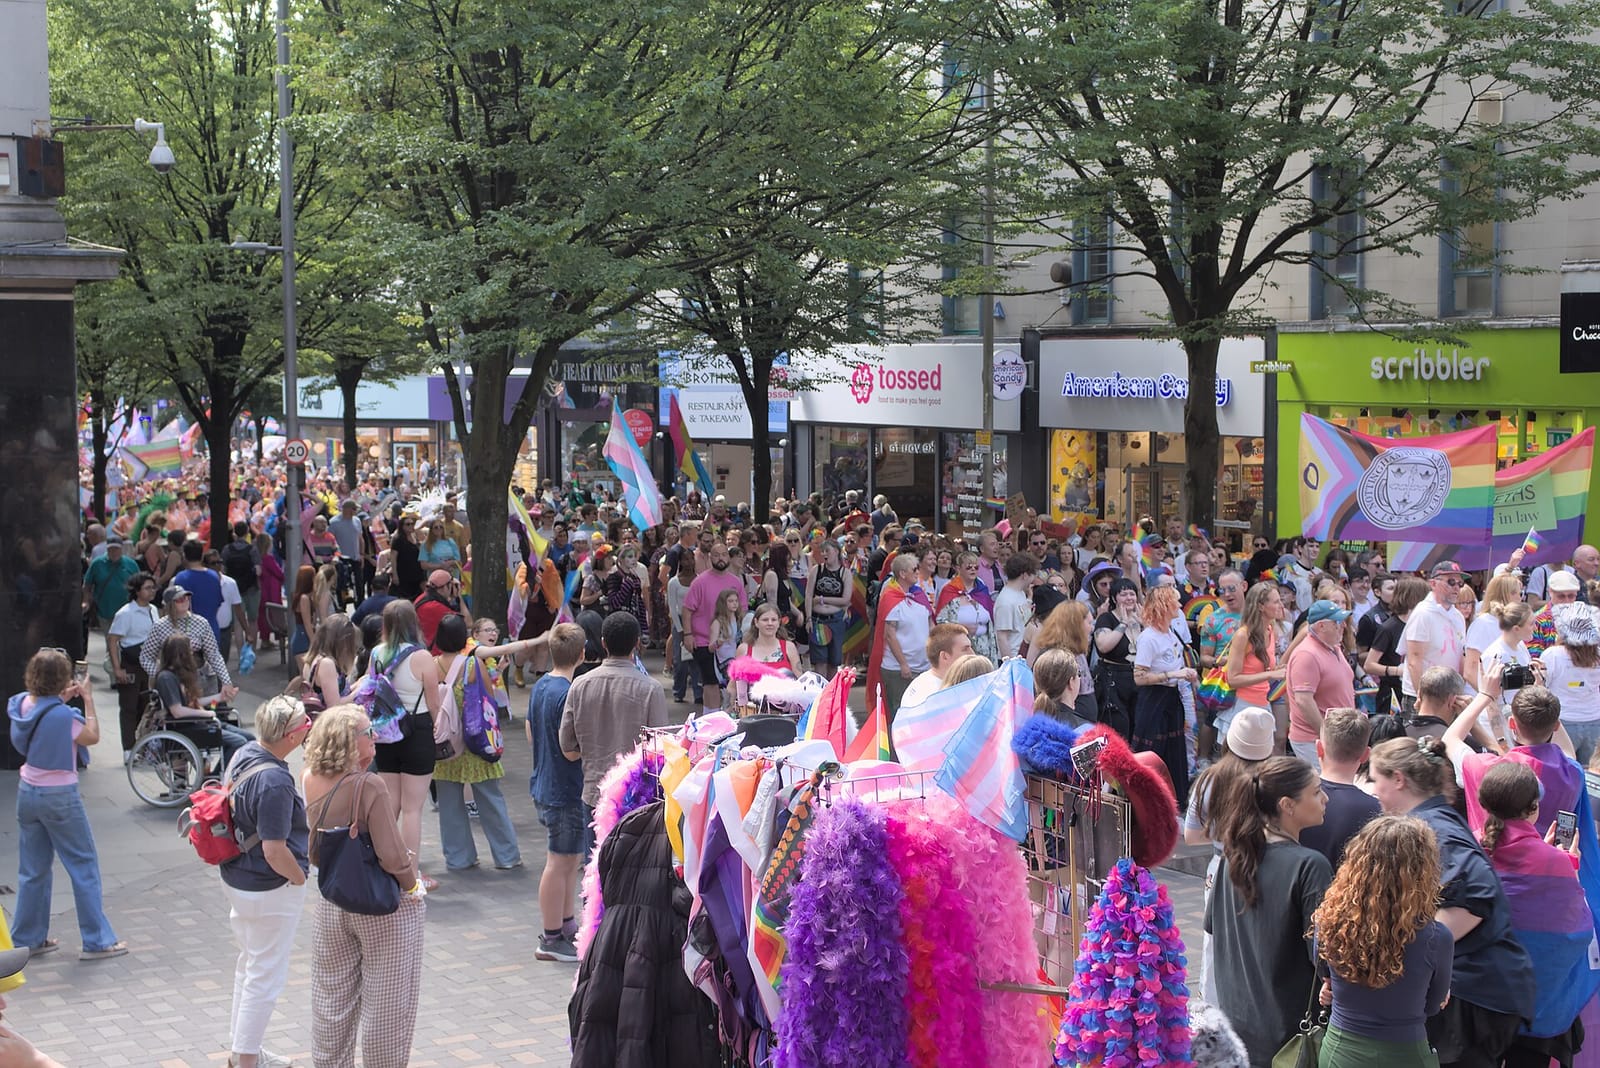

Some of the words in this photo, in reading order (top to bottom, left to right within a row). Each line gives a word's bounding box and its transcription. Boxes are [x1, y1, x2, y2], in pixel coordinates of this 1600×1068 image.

[1254, 361, 1292, 373] scribbler
[1370, 348, 1491, 381] scribbler
[878, 363, 942, 391] tossed
[993, 374, 1023, 384] Candy
[767, 389, 795, 399] ossed
[1062, 371, 1158, 399] American
[1158, 372, 1232, 408] Cay
[687, 401, 744, 412] RESTAURANT
[689, 414, 696, 423] &
[699, 414, 743, 423] TAKEAWAY
[287, 446, 305, 457] 20
[1498, 512, 1512, 525] in
[1515, 511, 1540, 524] law
